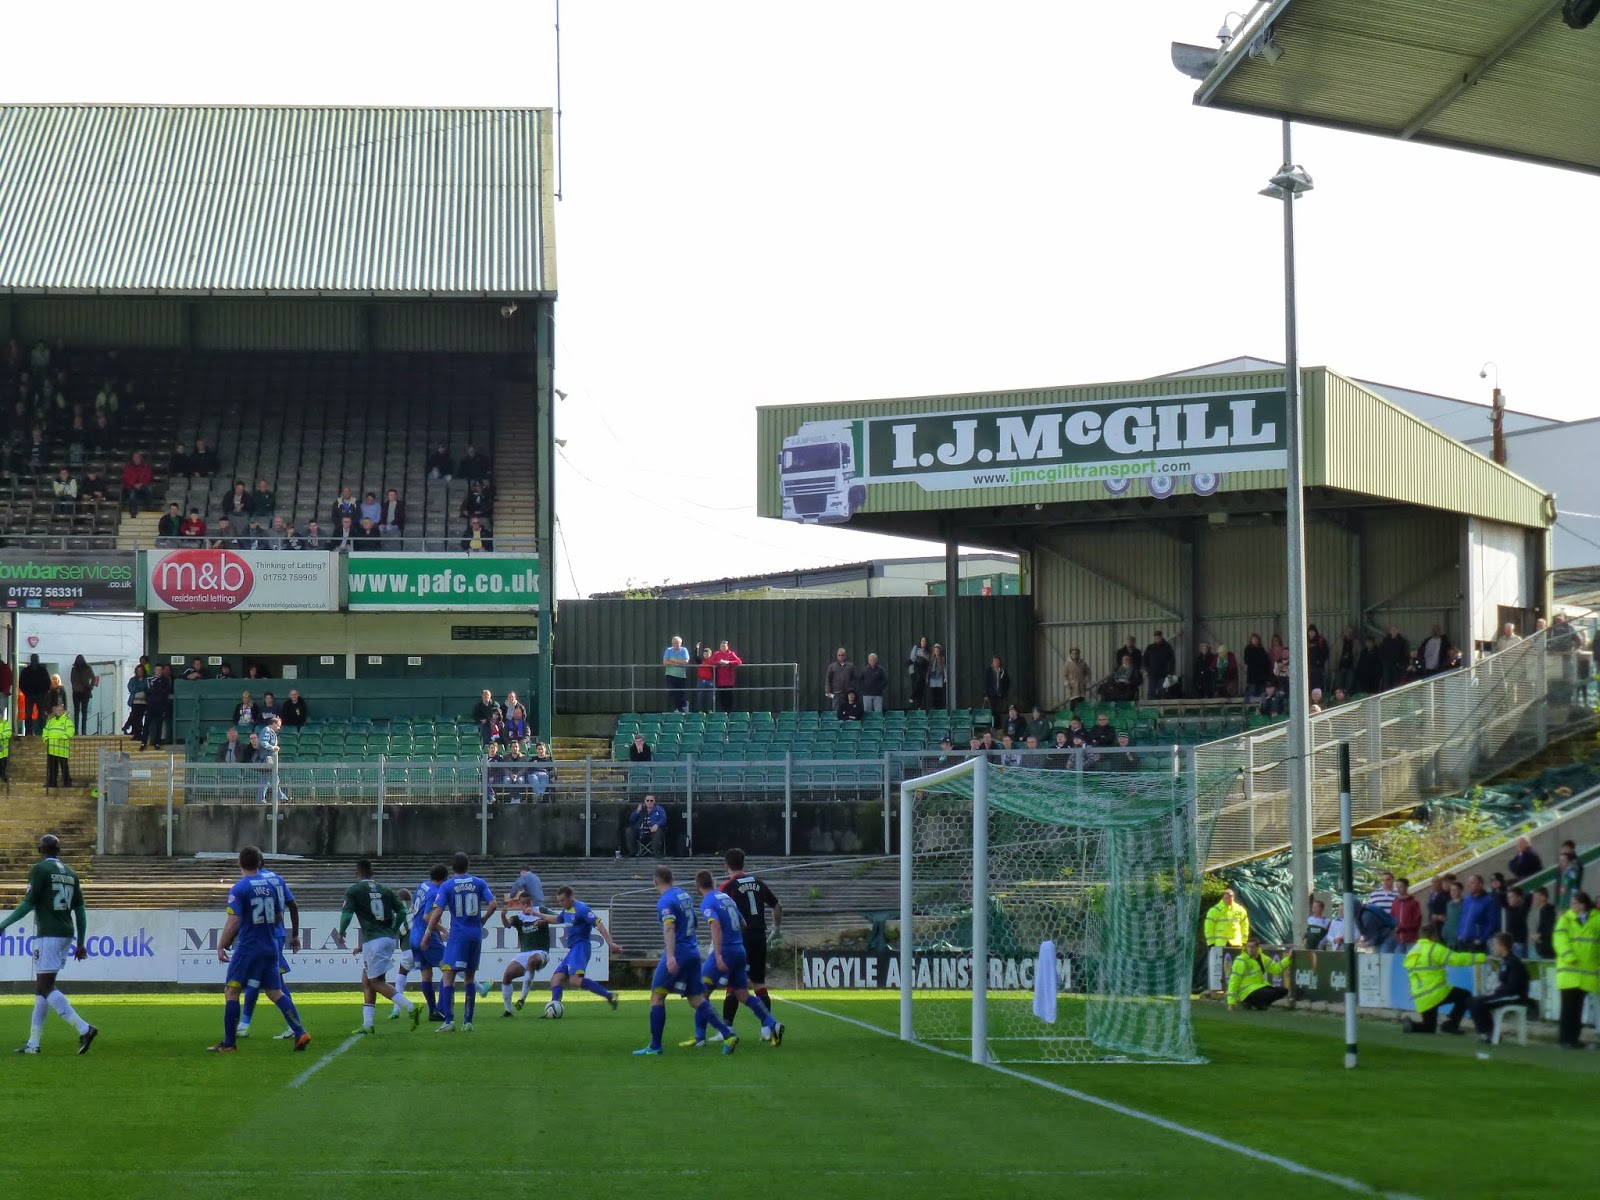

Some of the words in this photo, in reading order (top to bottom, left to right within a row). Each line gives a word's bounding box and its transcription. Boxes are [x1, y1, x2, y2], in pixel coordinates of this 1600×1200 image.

[973, 459, 1191, 486] www.ijmcgilltransport.com
[0, 560, 132, 580] owbarservices
[161, 553, 245, 592] m&b
[255, 562, 286, 570] Thinking
[296, 562, 326, 570] Letting?
[8, 587, 43, 598] 01752
[45, 587, 83, 598] 563311
[107, 580, 132, 589] .co.uk
[348, 568, 539, 597] www.pafc.co.uk
[171, 594, 209, 603] residential
[210, 594, 236, 605] lettings
[455, 892, 479, 918] 10
[746, 890, 758, 916] 1
[803, 957, 878, 988] ARGYLE
[886, 957, 974, 988] AAINS
[989, 957, 1072, 989] RACM
